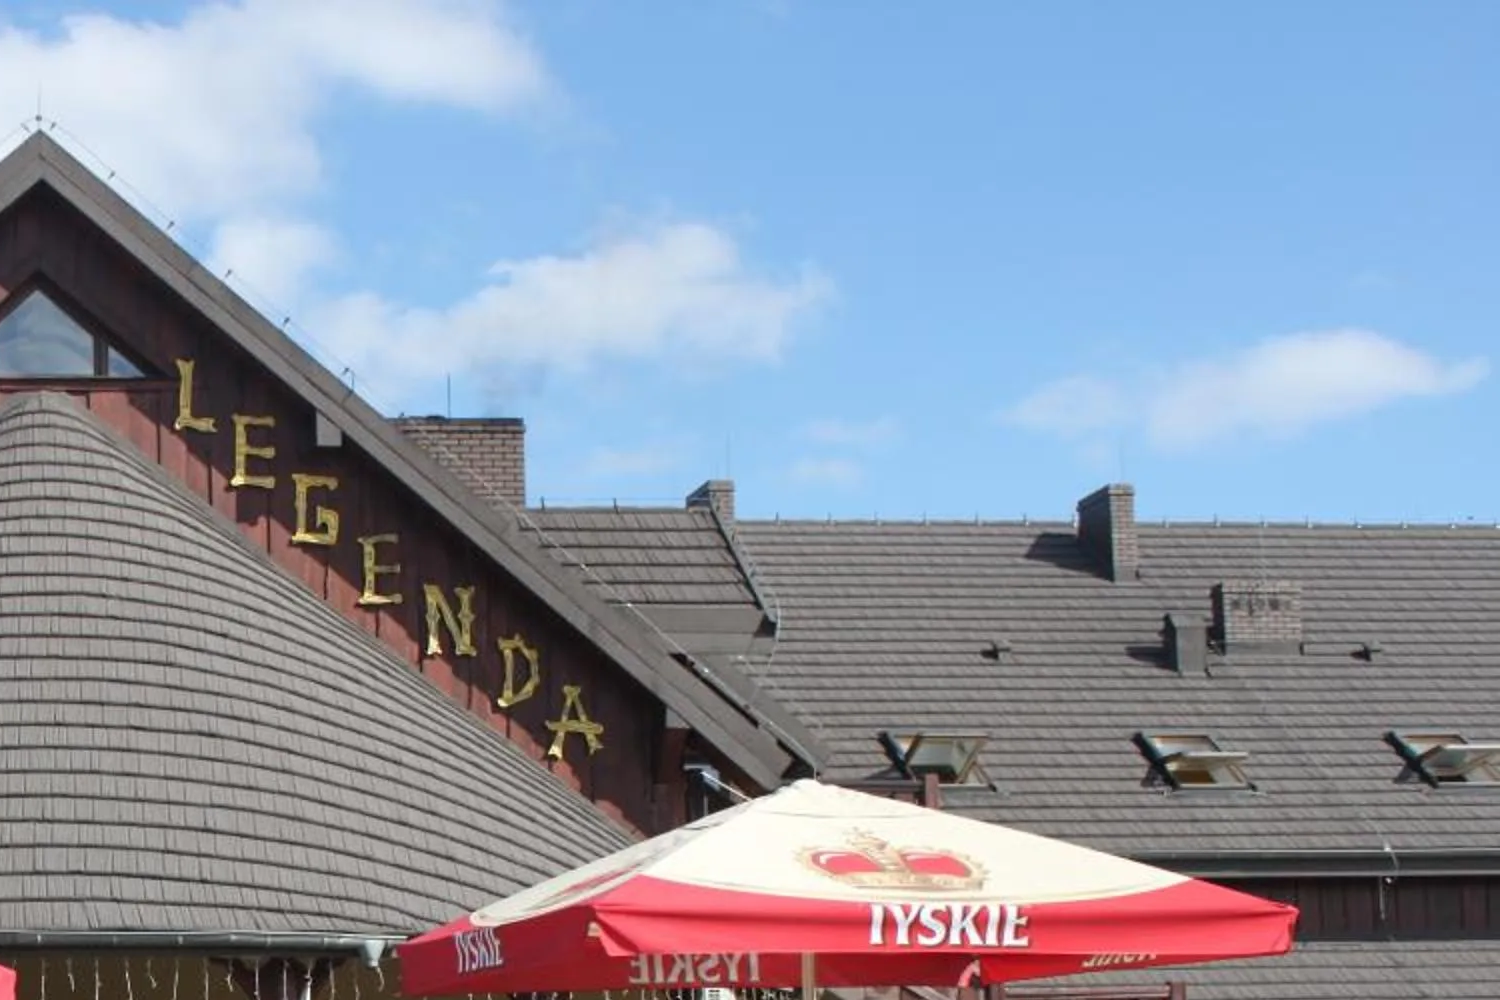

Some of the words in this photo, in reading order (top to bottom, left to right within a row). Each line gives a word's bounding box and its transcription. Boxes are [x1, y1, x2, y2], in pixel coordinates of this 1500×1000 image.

[174, 358, 603, 760] LEGENDA
[869, 902, 1030, 947] TYSKIE
[453, 926, 504, 974] TYSKIE
